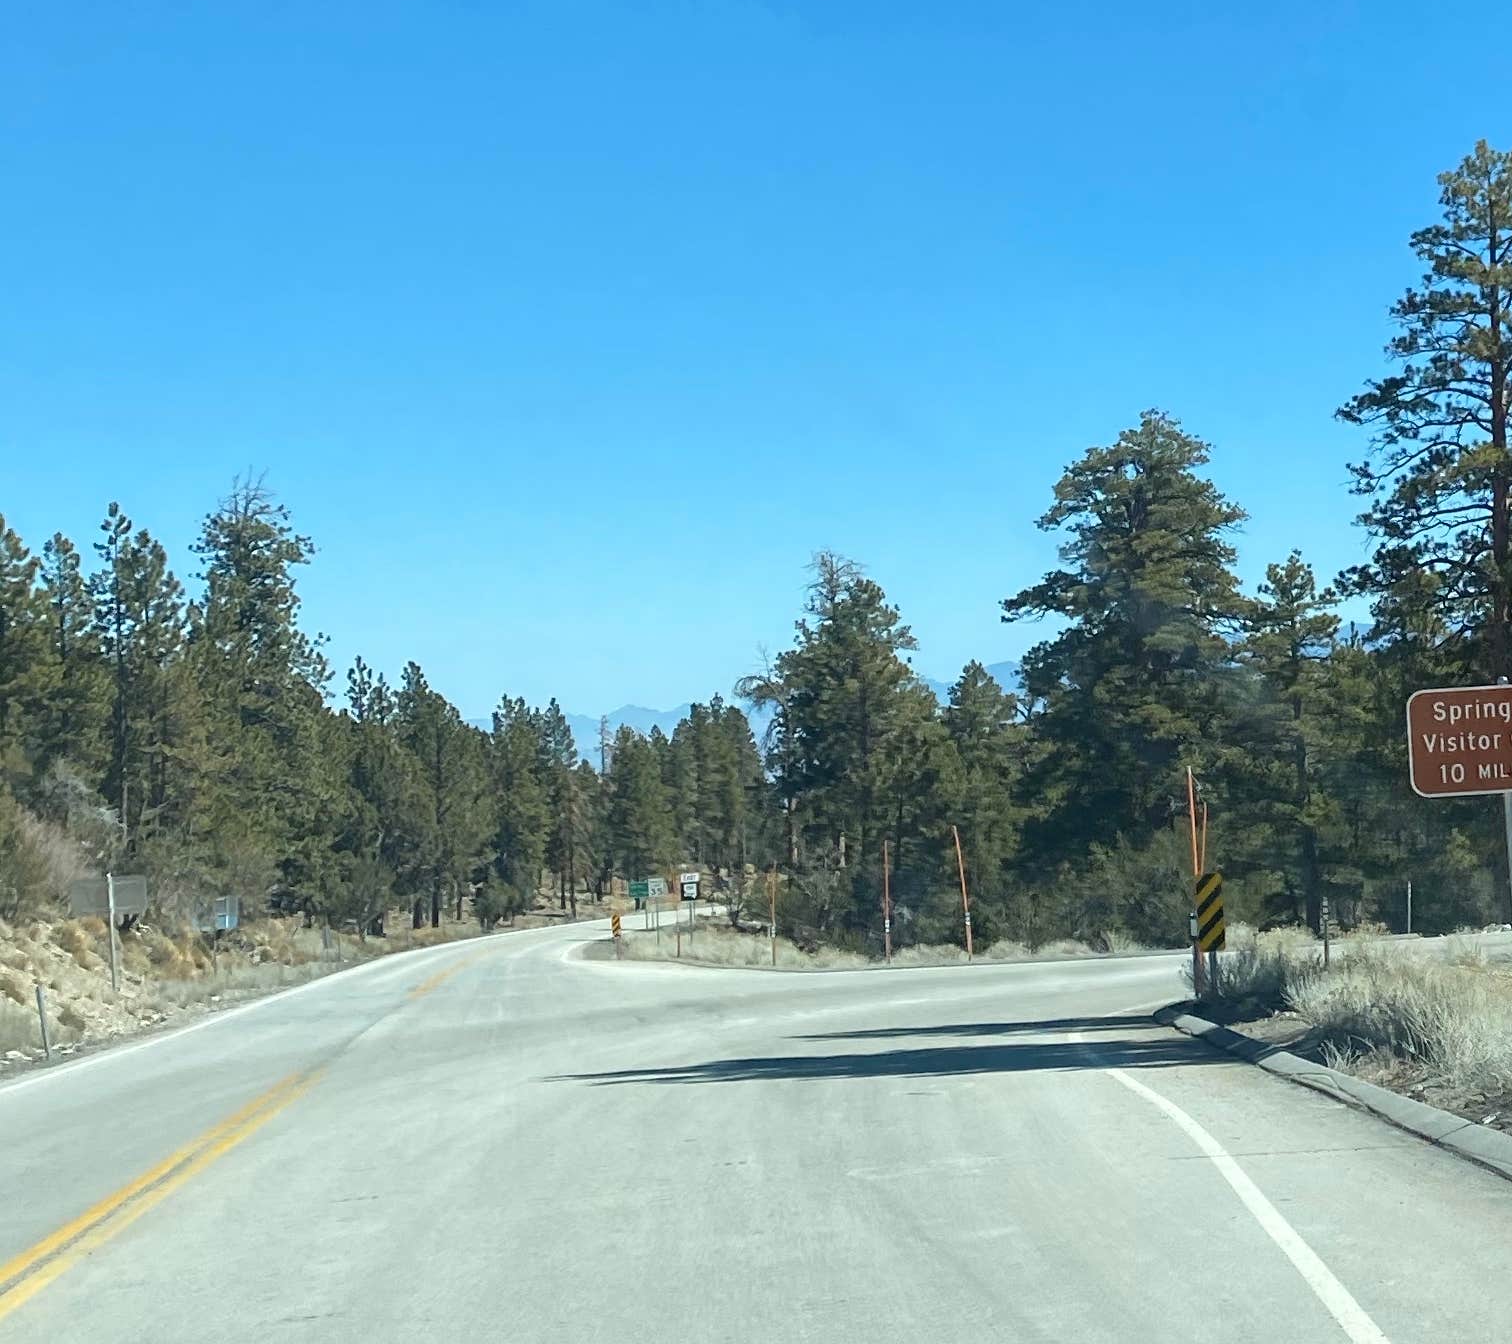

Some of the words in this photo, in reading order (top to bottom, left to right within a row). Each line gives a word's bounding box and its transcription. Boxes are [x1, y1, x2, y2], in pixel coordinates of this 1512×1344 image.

[1432, 699, 1511, 725] Spring
[1422, 731, 1502, 753] Visitor
[1439, 763, 1465, 784] 10
